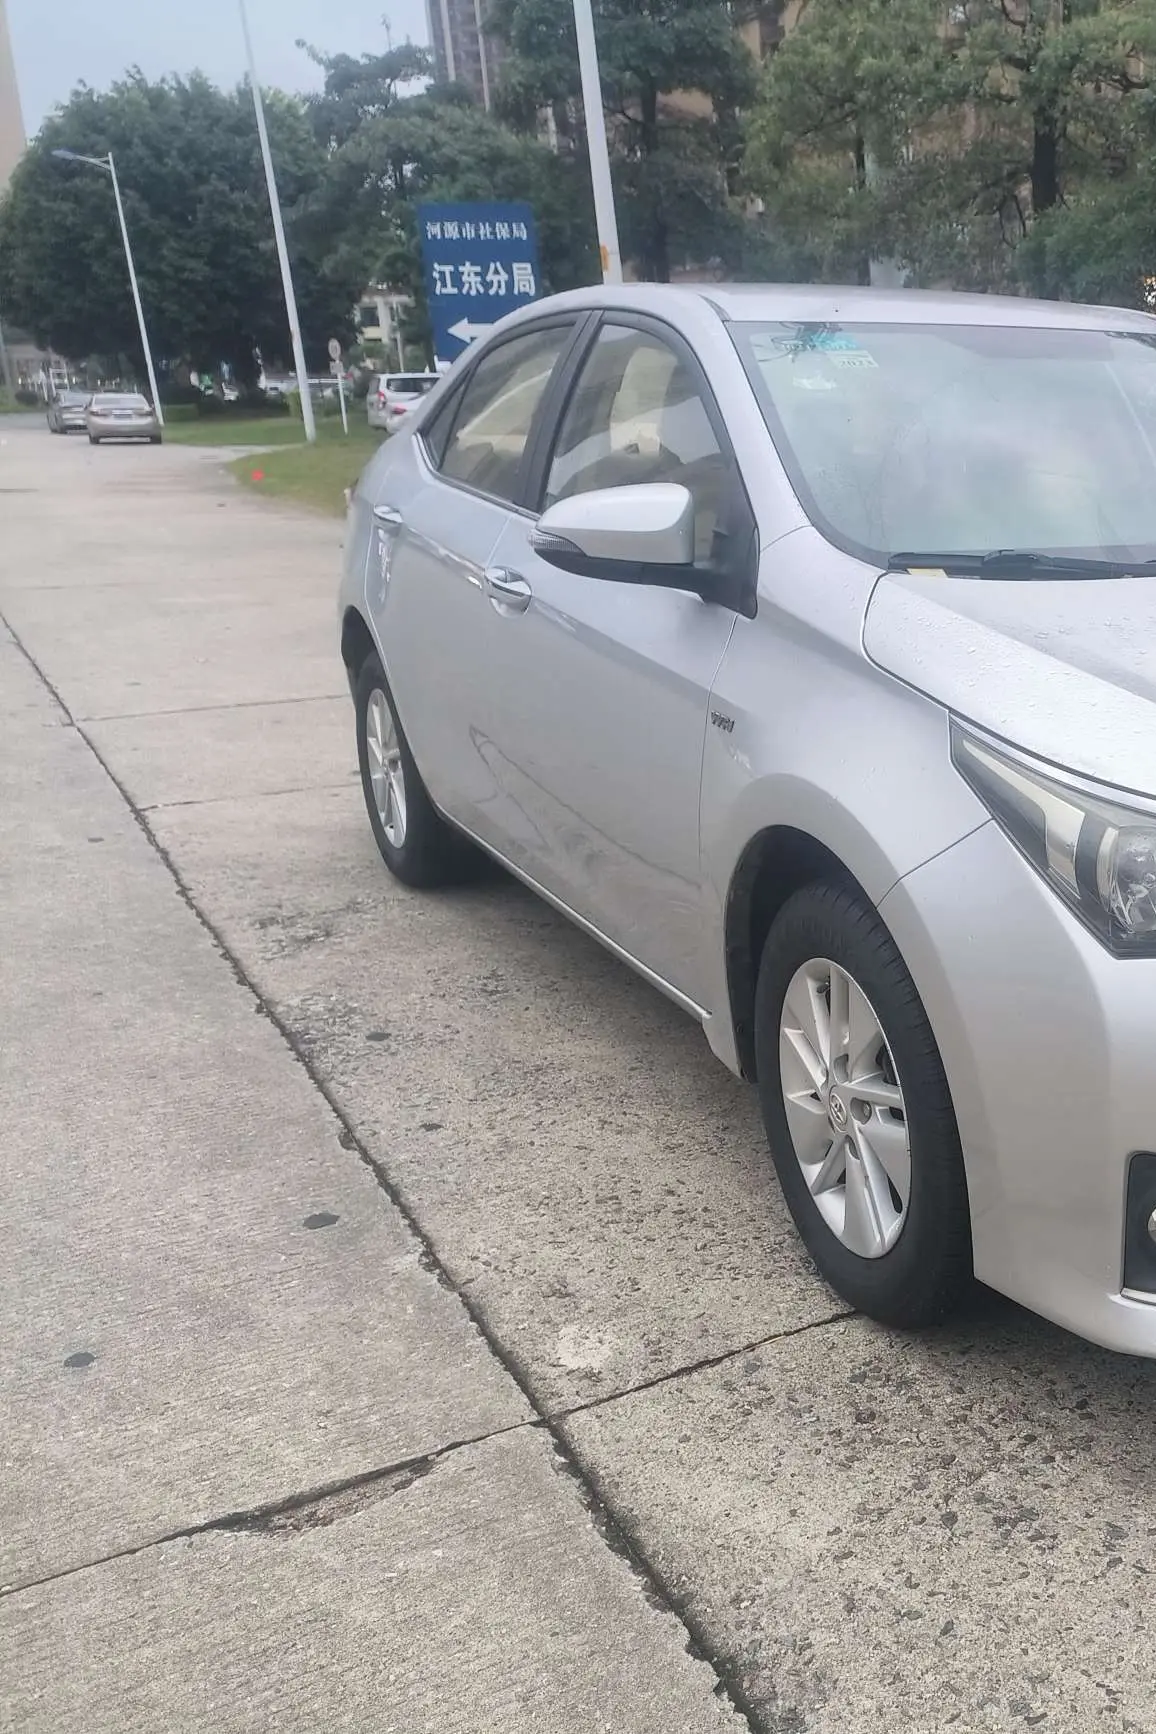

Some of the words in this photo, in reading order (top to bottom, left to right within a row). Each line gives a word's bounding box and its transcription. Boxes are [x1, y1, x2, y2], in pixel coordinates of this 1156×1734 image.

[426, 221, 527, 240] 河源市社保局
[433, 261, 535, 296] 江东分局
